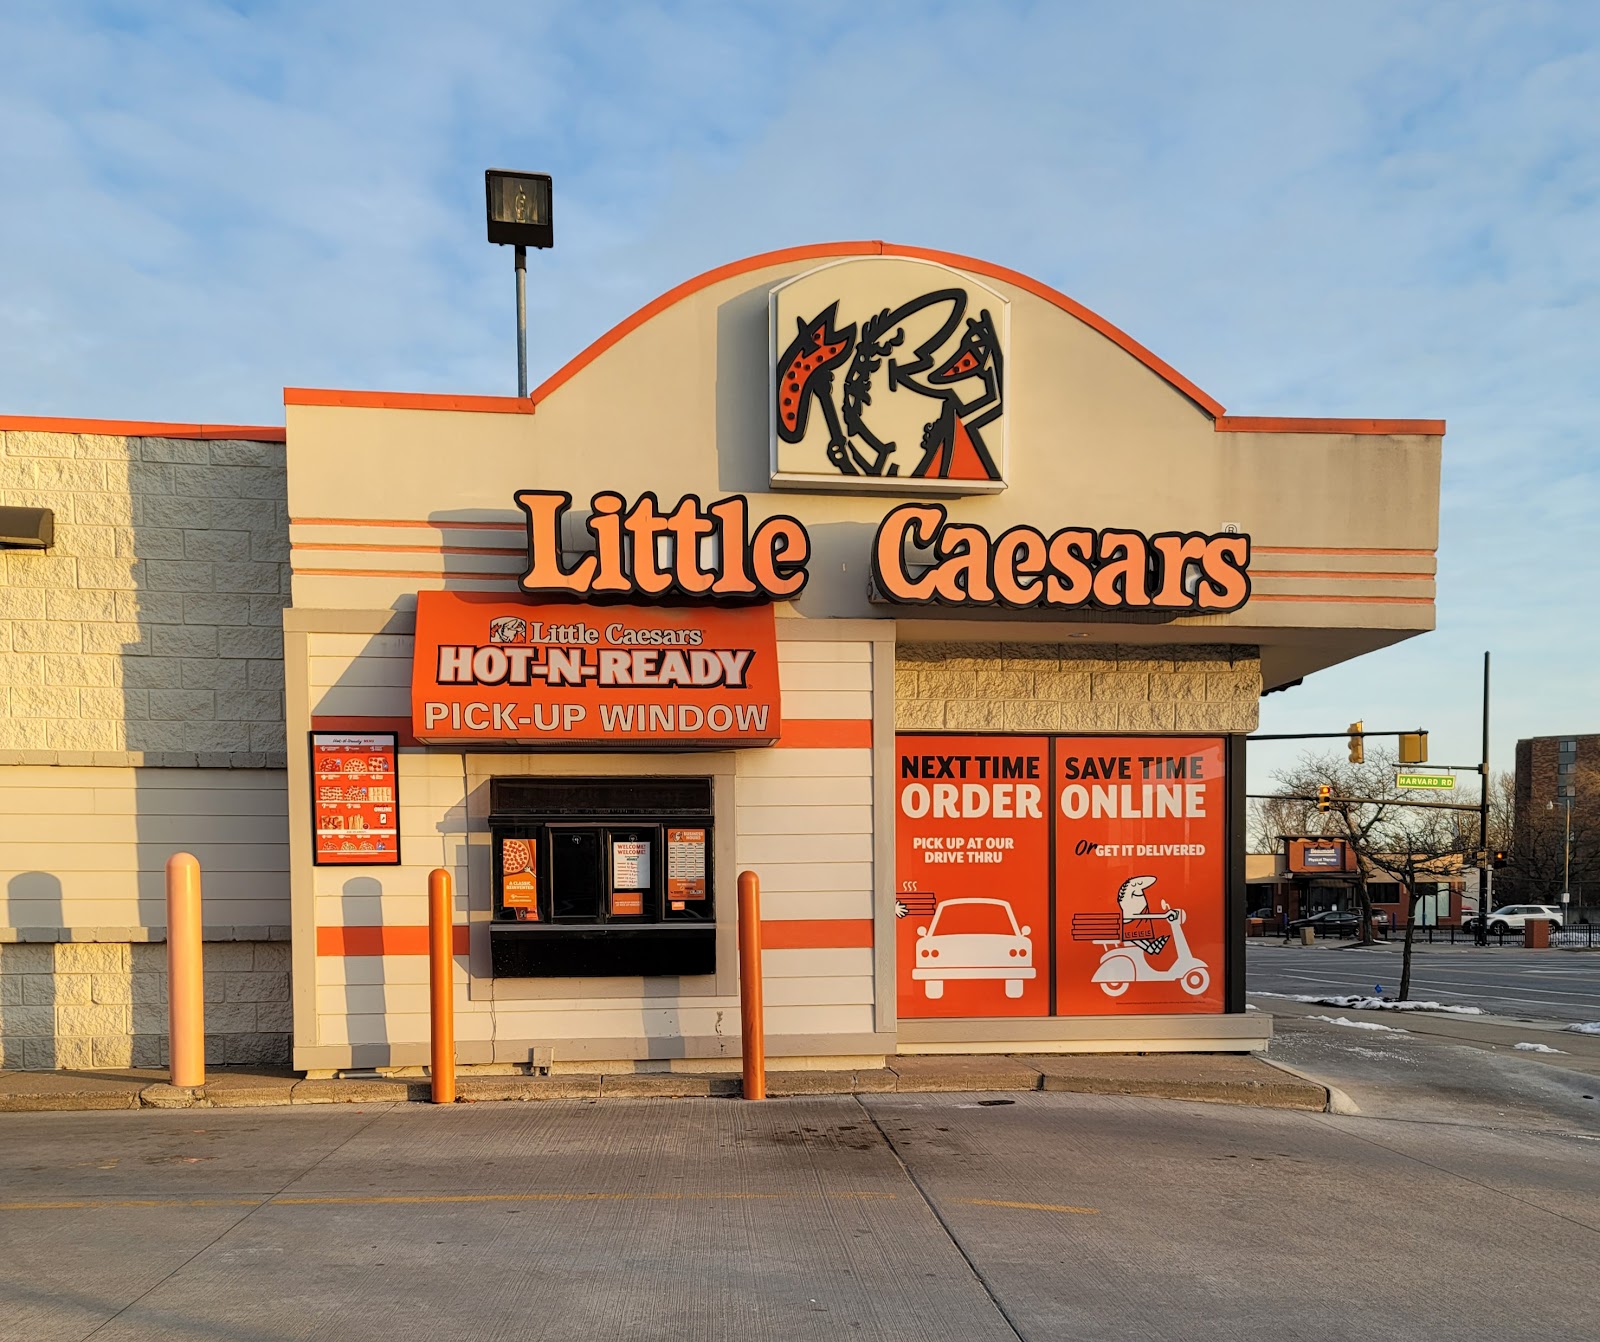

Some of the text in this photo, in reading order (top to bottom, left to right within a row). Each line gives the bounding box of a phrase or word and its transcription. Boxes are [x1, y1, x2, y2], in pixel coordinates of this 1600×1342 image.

[513, 490, 1251, 613] Little Caesars
[530, 622, 703, 646] Little Caesars
[436, 645, 755, 689] HOT-N-READY
[425, 702, 770, 732] PICK-UP WINDOW
[901, 755, 1040, 779] NEXT TIME
[1065, 757, 1204, 779] SAVE TIME
[1399, 777, 1453, 786] HARVARD RD
[901, 783, 1043, 819] ORDER
[1061, 784, 1207, 819] ONLINE
[913, 837, 1014, 850] PICK UP AT OUR
[1075, 839, 1206, 857] Or GET IT DELIVERED
[924, 851, 1003, 864] DRIVE THRU
